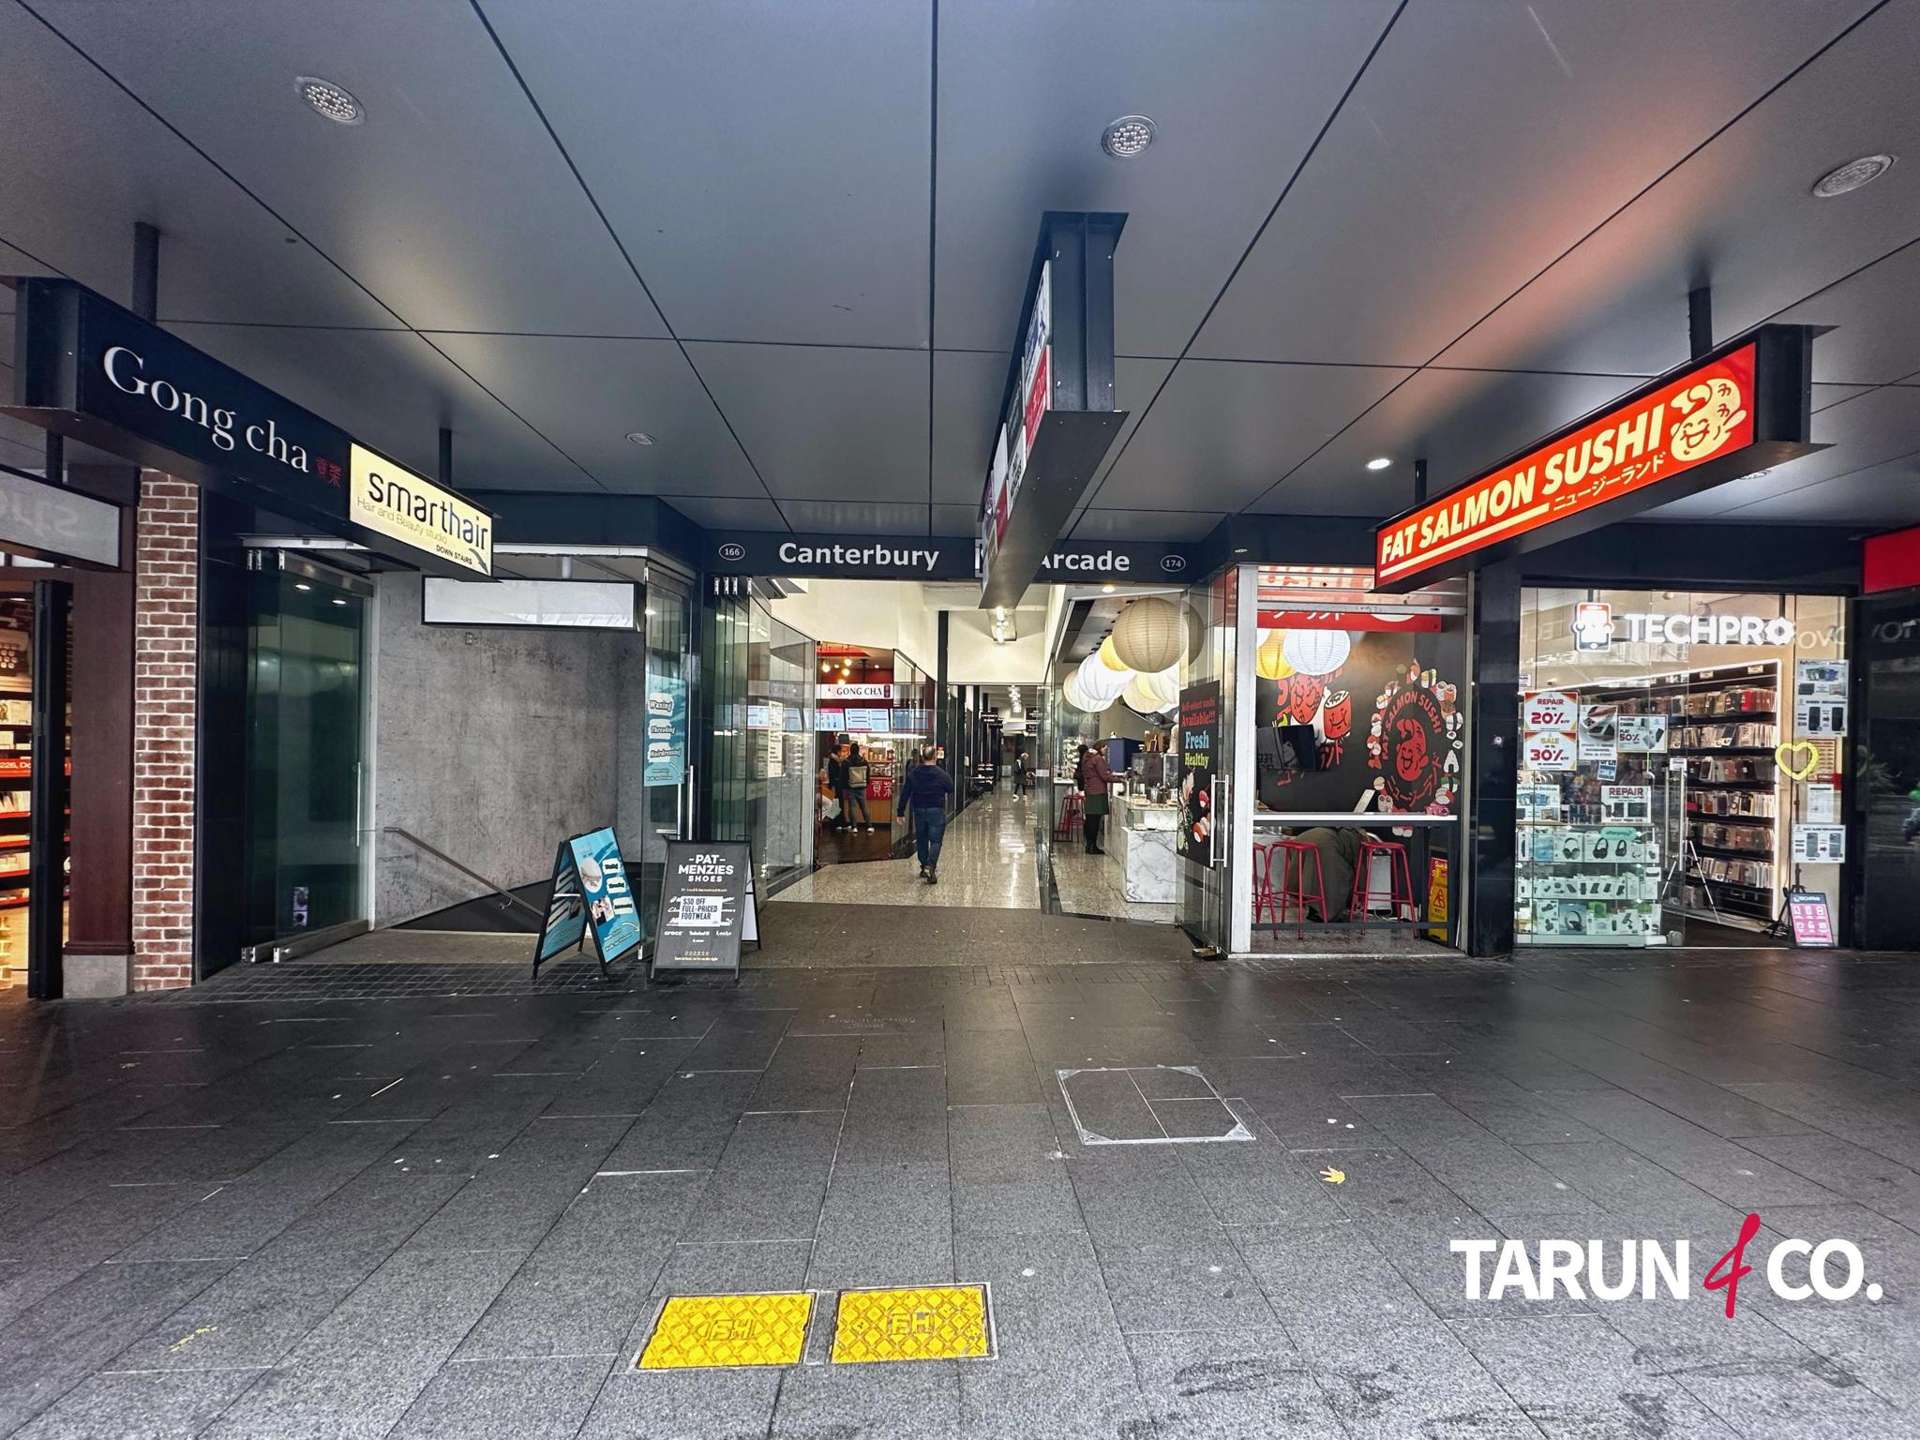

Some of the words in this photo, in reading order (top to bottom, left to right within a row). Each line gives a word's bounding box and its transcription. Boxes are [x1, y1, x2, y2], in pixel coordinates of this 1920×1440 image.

[104, 346, 237, 451] Gong
[246, 419, 309, 473] cha
[1381, 523, 1417, 565] FAT
[1418, 466, 1536, 549] SALMON
[1542, 403, 1665, 495] SUSHI
[1553, 450, 1666, 511] ニュージーランド
[357, 496, 375, 512] Hair
[377, 507, 394, 521] and
[396, 511, 424, 536] Beauty
[436, 544, 454, 557] DOWN
[454, 552, 473, 565] STAIRS
[724, 547, 740, 556] 166
[779, 542, 939, 571] Canterbury
[1165, 558, 1182, 568] 174
[1624, 613, 1795, 646] TECHPRO
[836, 687, 862, 695] GONG
[864, 687, 882, 695] CHA
[1385, 690, 1419, 732] SALMON
[1418, 694, 1443, 734] SUSHI
[1531, 712, 1564, 725] 20%
[1185, 730, 1209, 749] Fresh
[1185, 752, 1209, 769] Healthy
[1530, 749, 1564, 761] 30%
[678, 865, 734, 875] MENZIES
